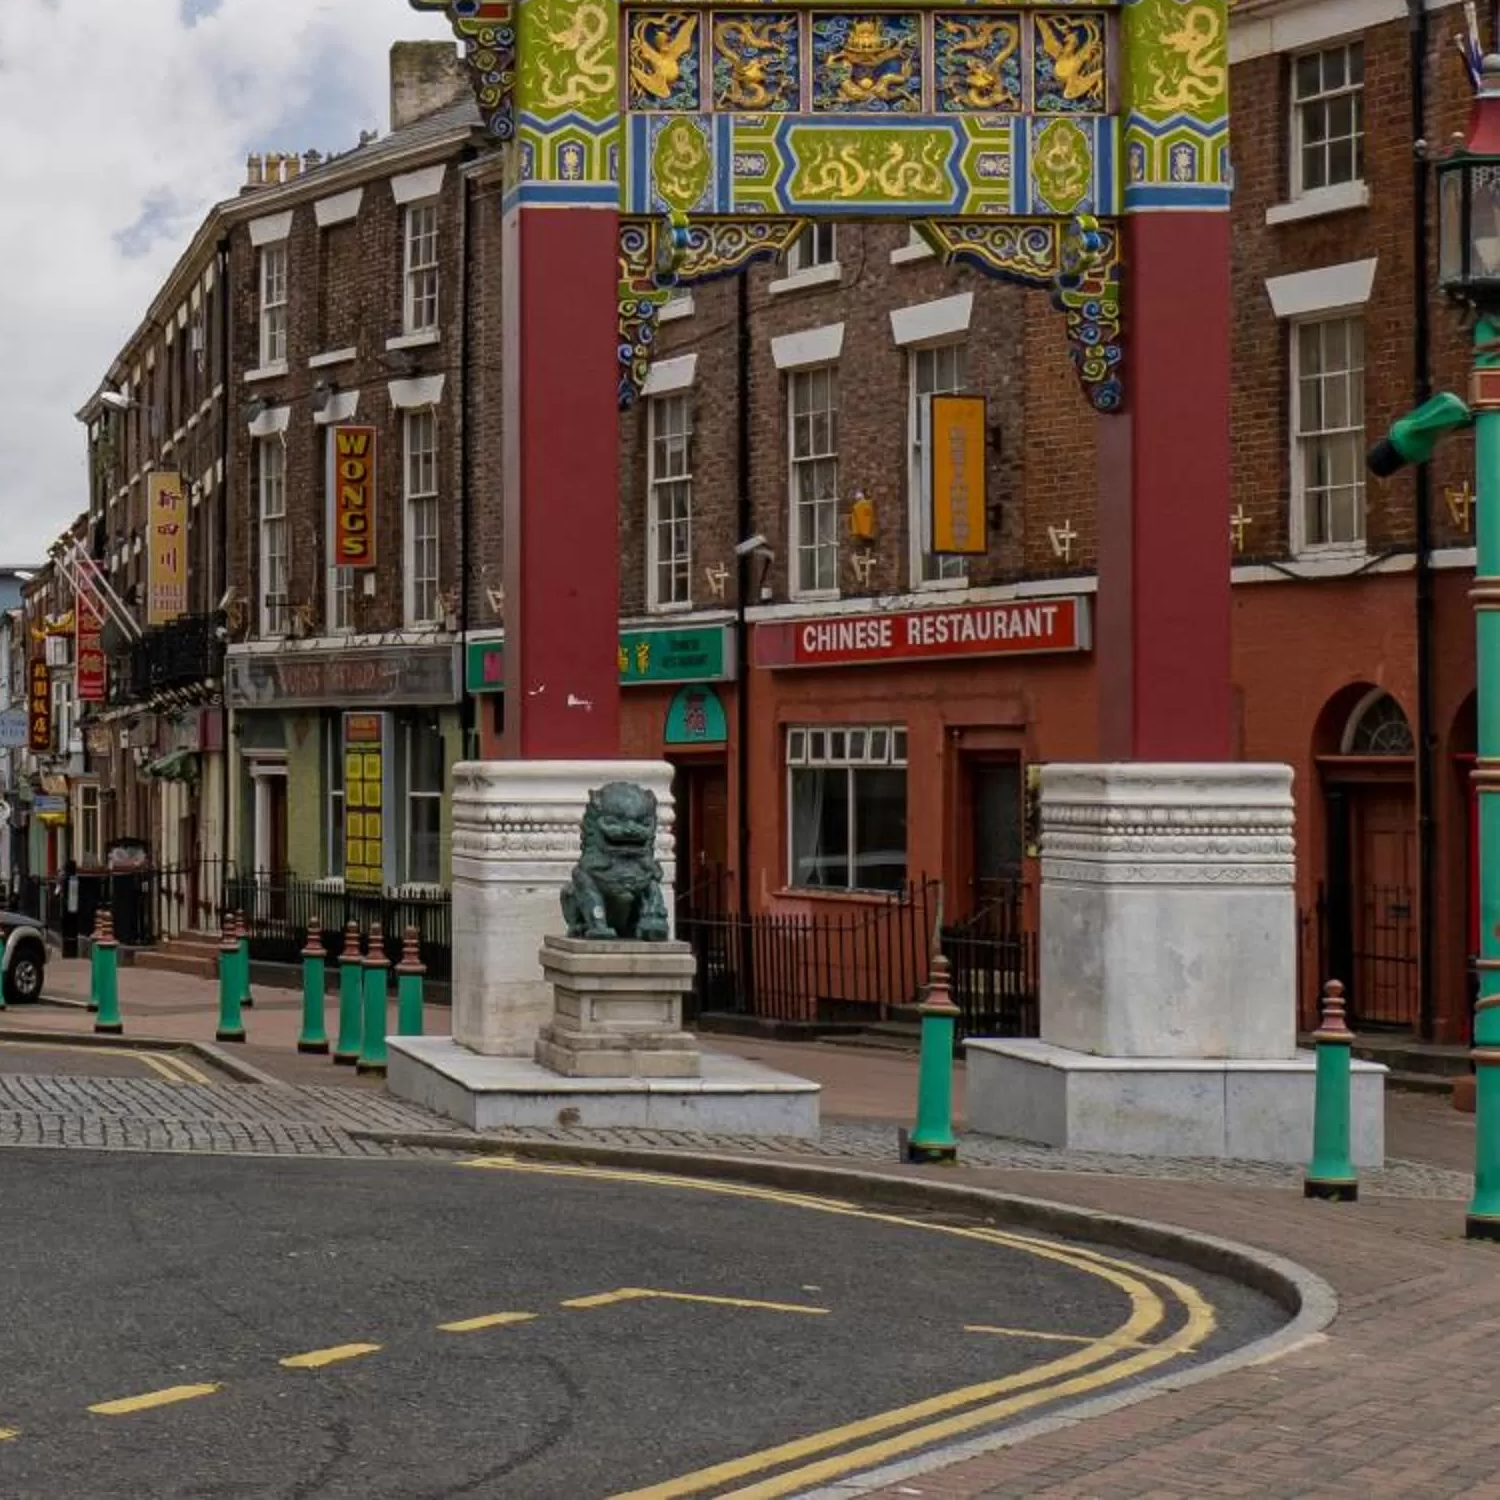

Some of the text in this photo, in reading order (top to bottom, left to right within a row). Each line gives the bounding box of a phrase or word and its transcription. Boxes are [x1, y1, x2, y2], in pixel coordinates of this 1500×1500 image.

[338, 434, 368, 557] WONGS
[802, 605, 1059, 653] CHINESE RESTAURANT
